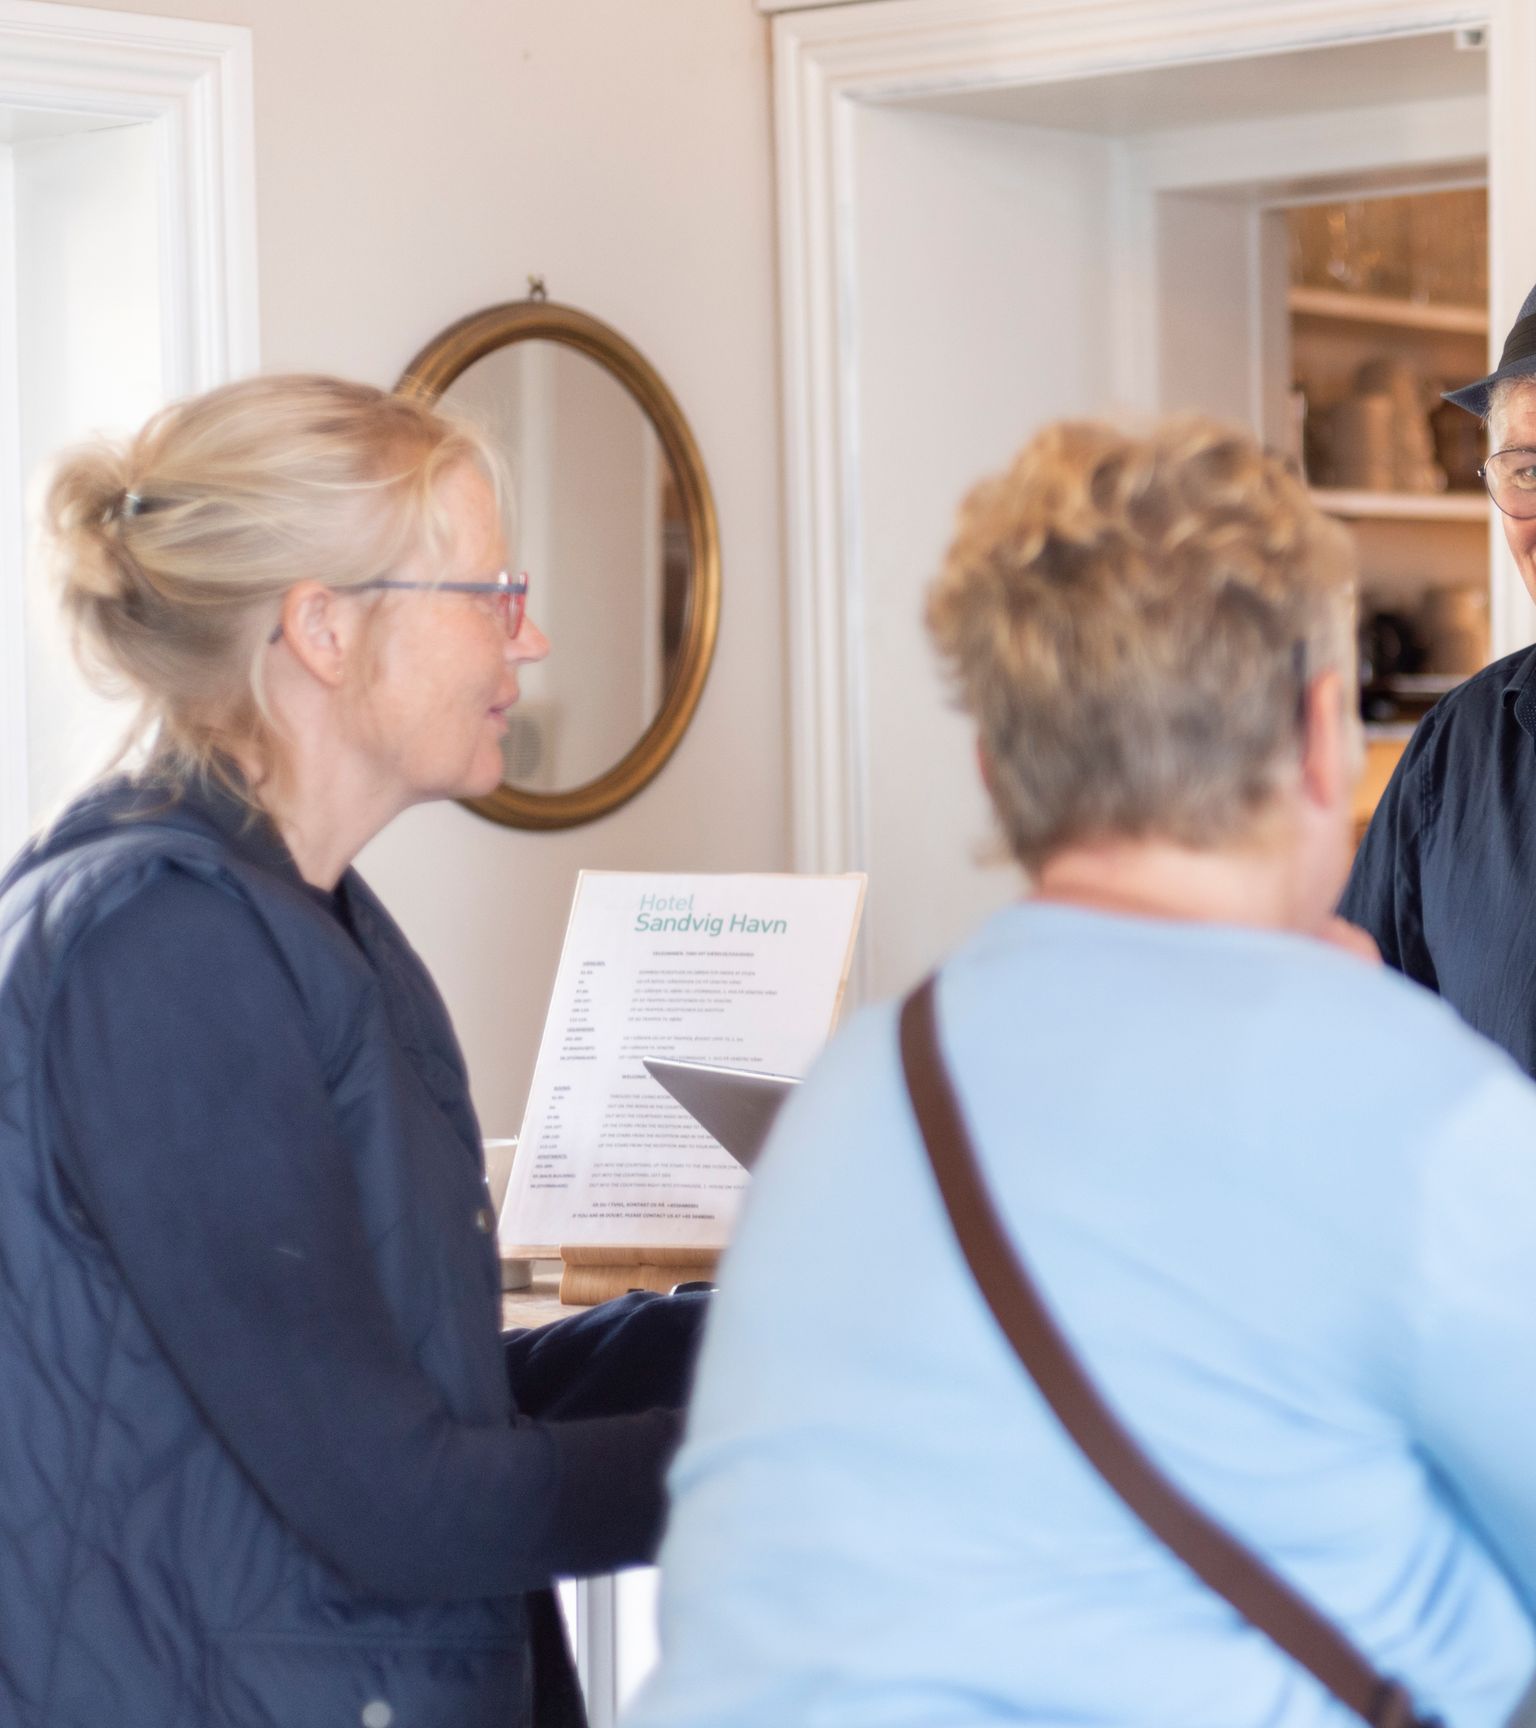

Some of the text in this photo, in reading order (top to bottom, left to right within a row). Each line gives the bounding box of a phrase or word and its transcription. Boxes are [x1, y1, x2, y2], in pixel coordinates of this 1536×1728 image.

[639, 893, 695, 912] Hotel
[634, 913, 788, 937] Sandvig Havn
